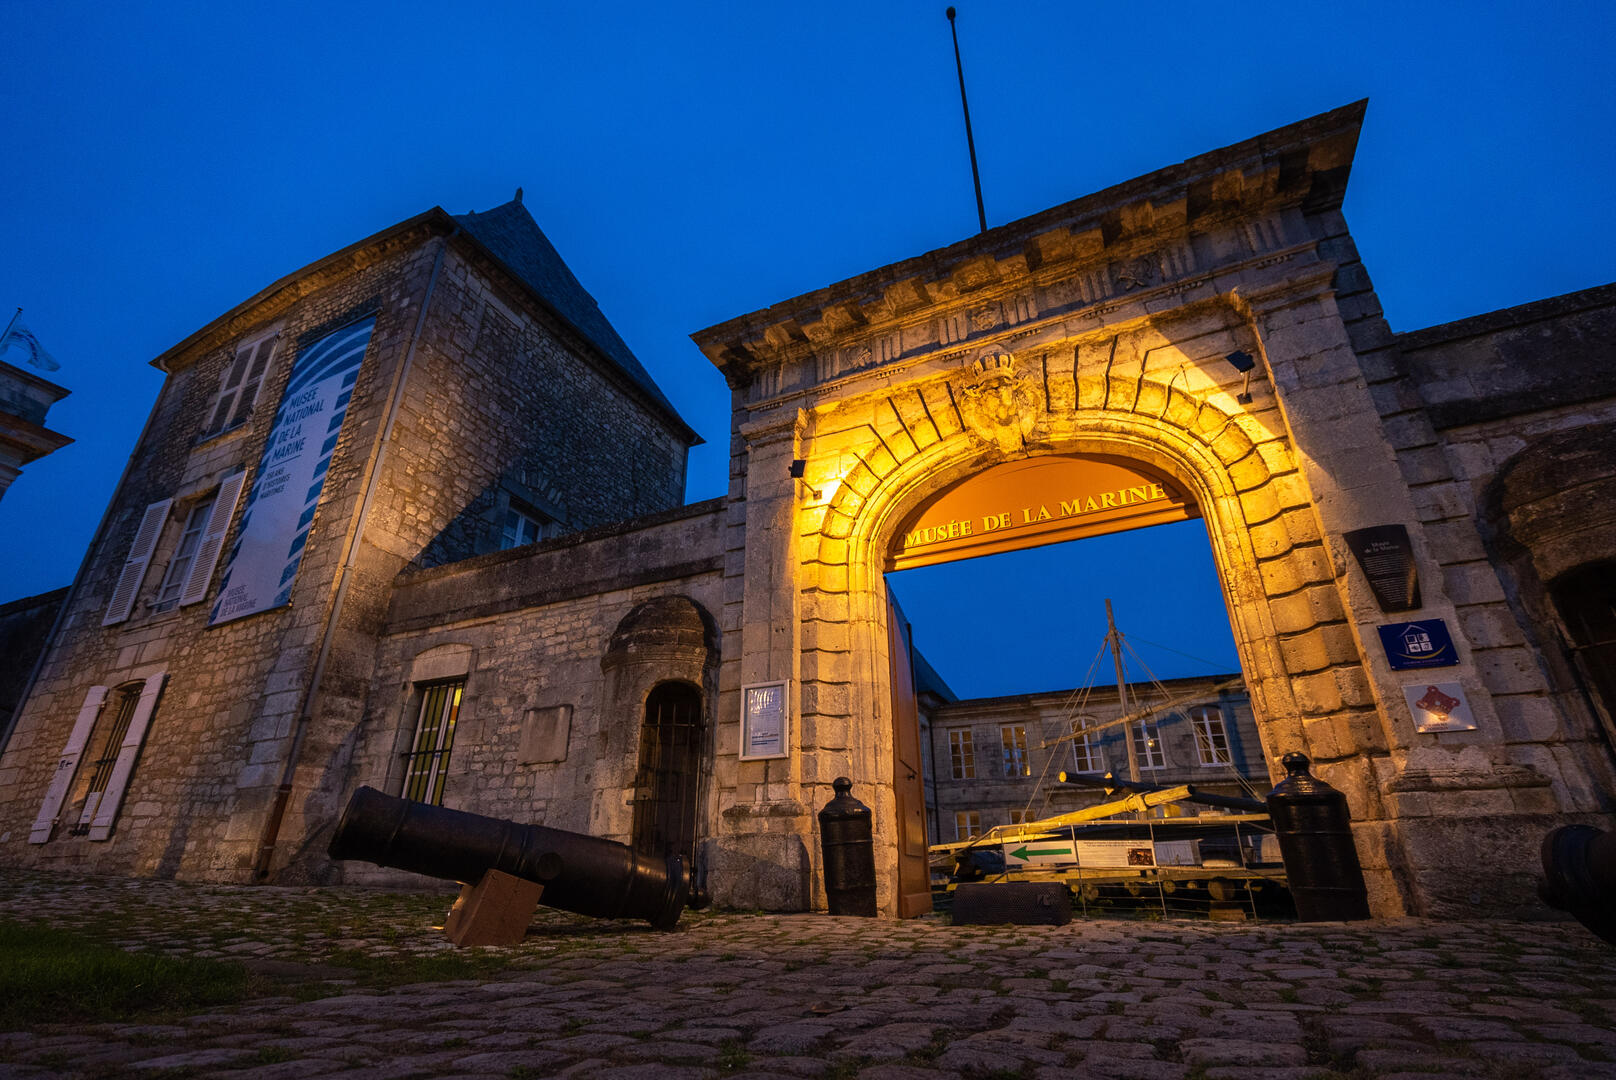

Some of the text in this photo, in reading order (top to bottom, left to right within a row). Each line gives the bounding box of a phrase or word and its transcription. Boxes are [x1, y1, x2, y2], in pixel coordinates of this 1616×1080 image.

[290, 386, 319, 409] MUSÉE
[284, 400, 324, 426] NATIONAL
[278, 424, 302, 444] DE LA
[272, 437, 306, 461] MARINE
[903, 483, 1166, 547] MUSÉE DE LA MARINE
